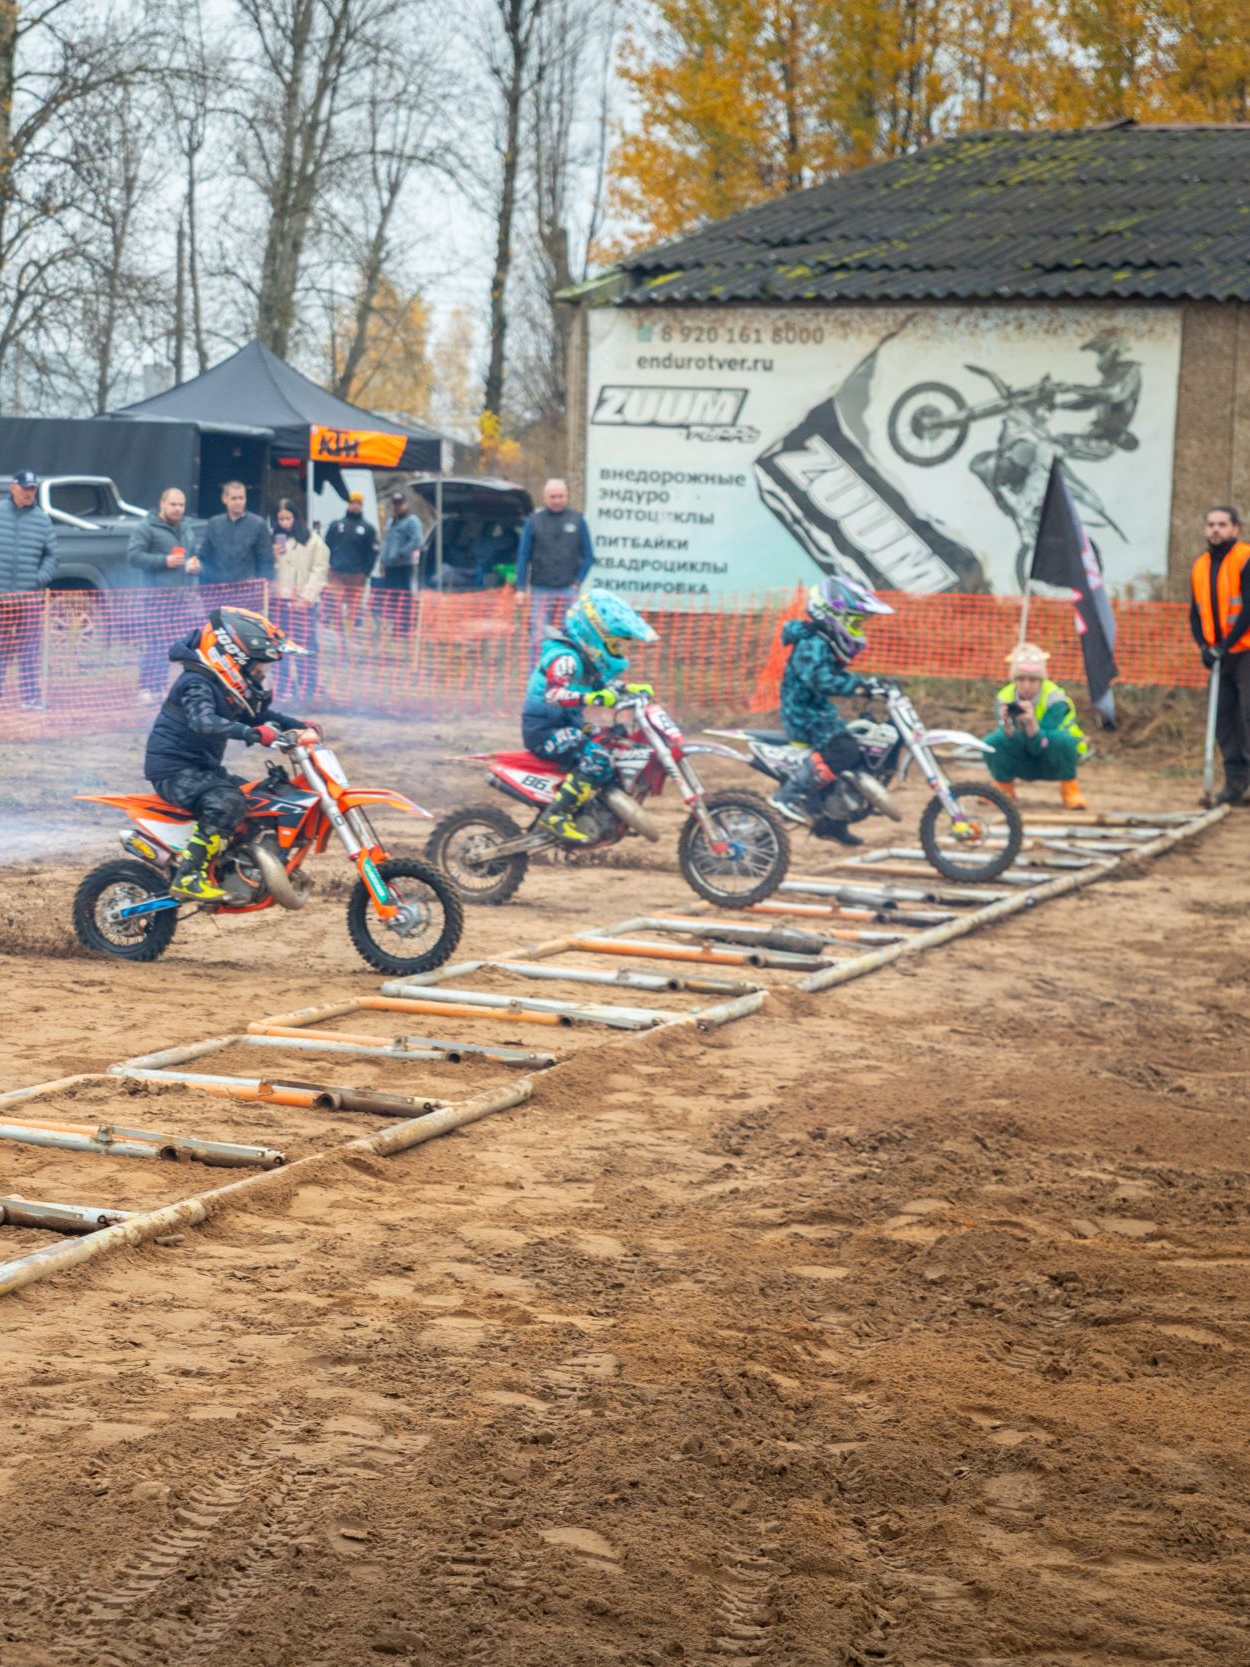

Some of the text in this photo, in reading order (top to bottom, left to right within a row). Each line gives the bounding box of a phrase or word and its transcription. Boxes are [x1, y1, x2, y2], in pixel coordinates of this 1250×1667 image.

[661, 325, 824, 344] 8 920 161 8000
[637, 352, 773, 372] endurotver.ru
[599, 468, 746, 487] внедорожные
[598, 487, 670, 505] эндуро
[595, 533, 689, 550] ПИТБАЙКИ
[595, 556, 729, 574] КВАДРОЦИКЛЫ
[593, 577, 710, 594] ЭКИПИРОВКА
[213, 627, 251, 665] 100%
